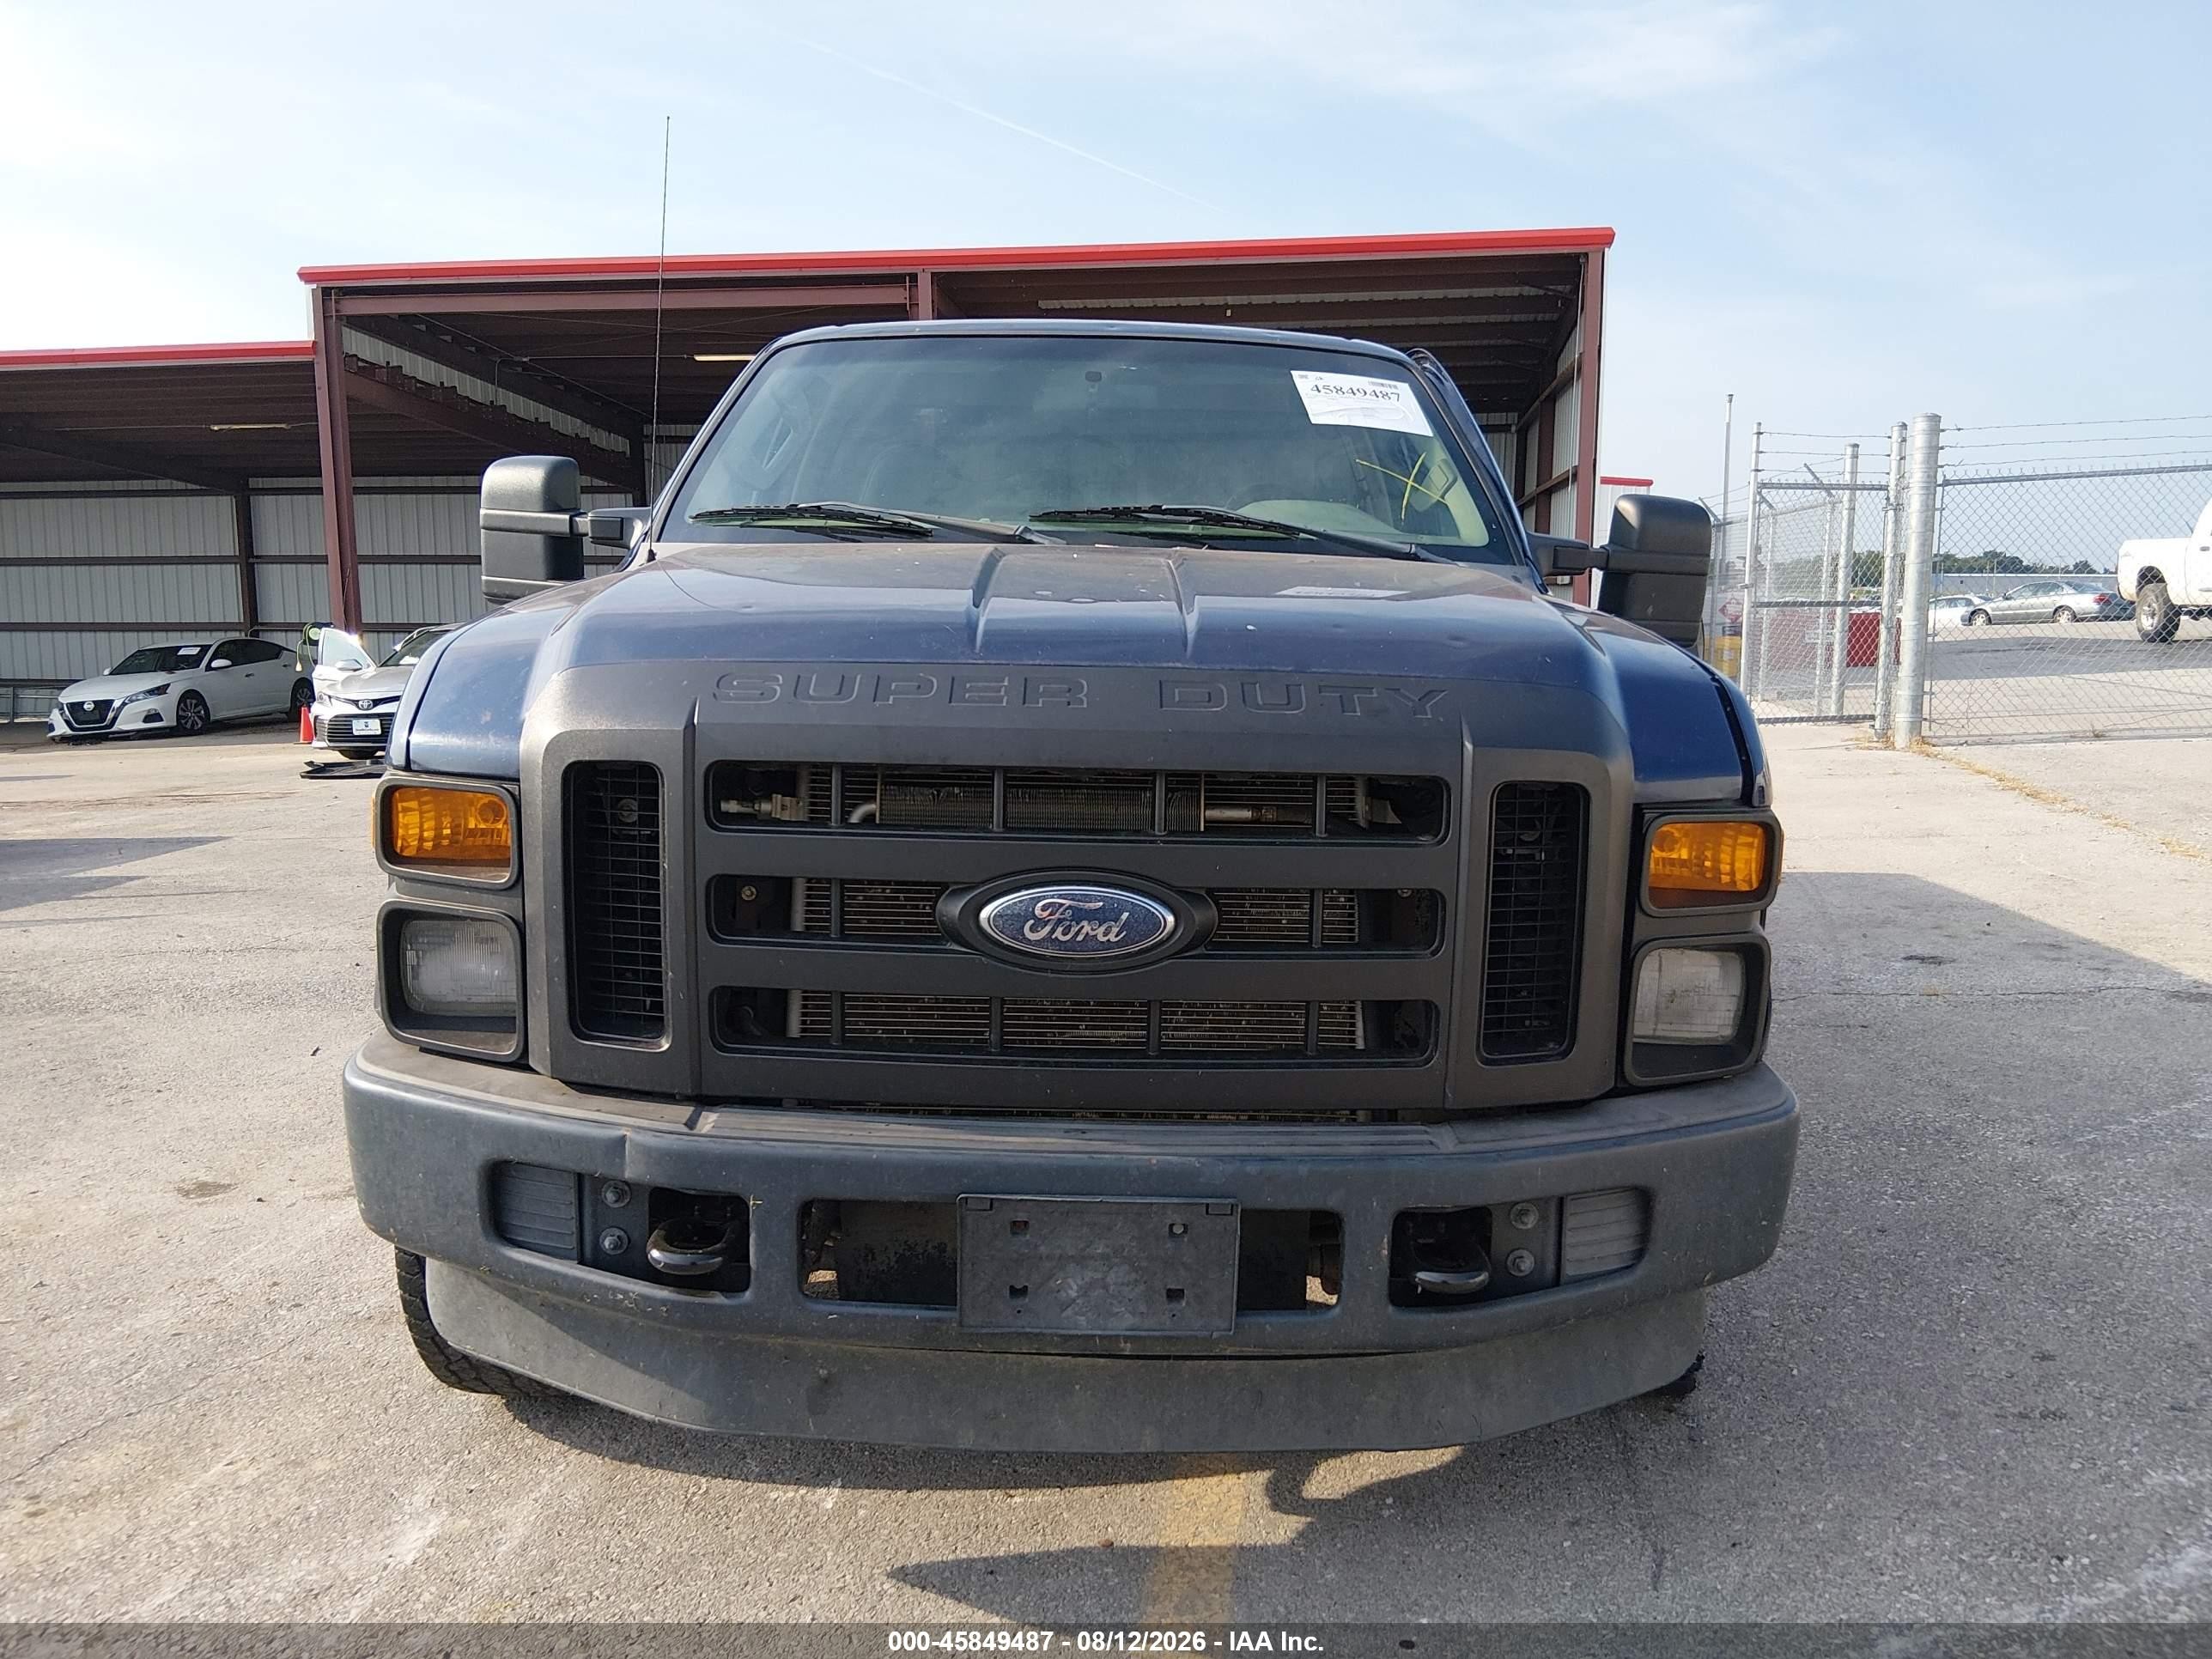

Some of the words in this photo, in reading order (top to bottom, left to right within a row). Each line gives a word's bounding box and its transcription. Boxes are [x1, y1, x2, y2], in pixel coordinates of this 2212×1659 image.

[1310, 384, 1400, 402] 45849487
[713, 672, 1088, 708] SUPER
[1158, 679, 1448, 718] DUTY
[1024, 898, 1129, 942] Ford
